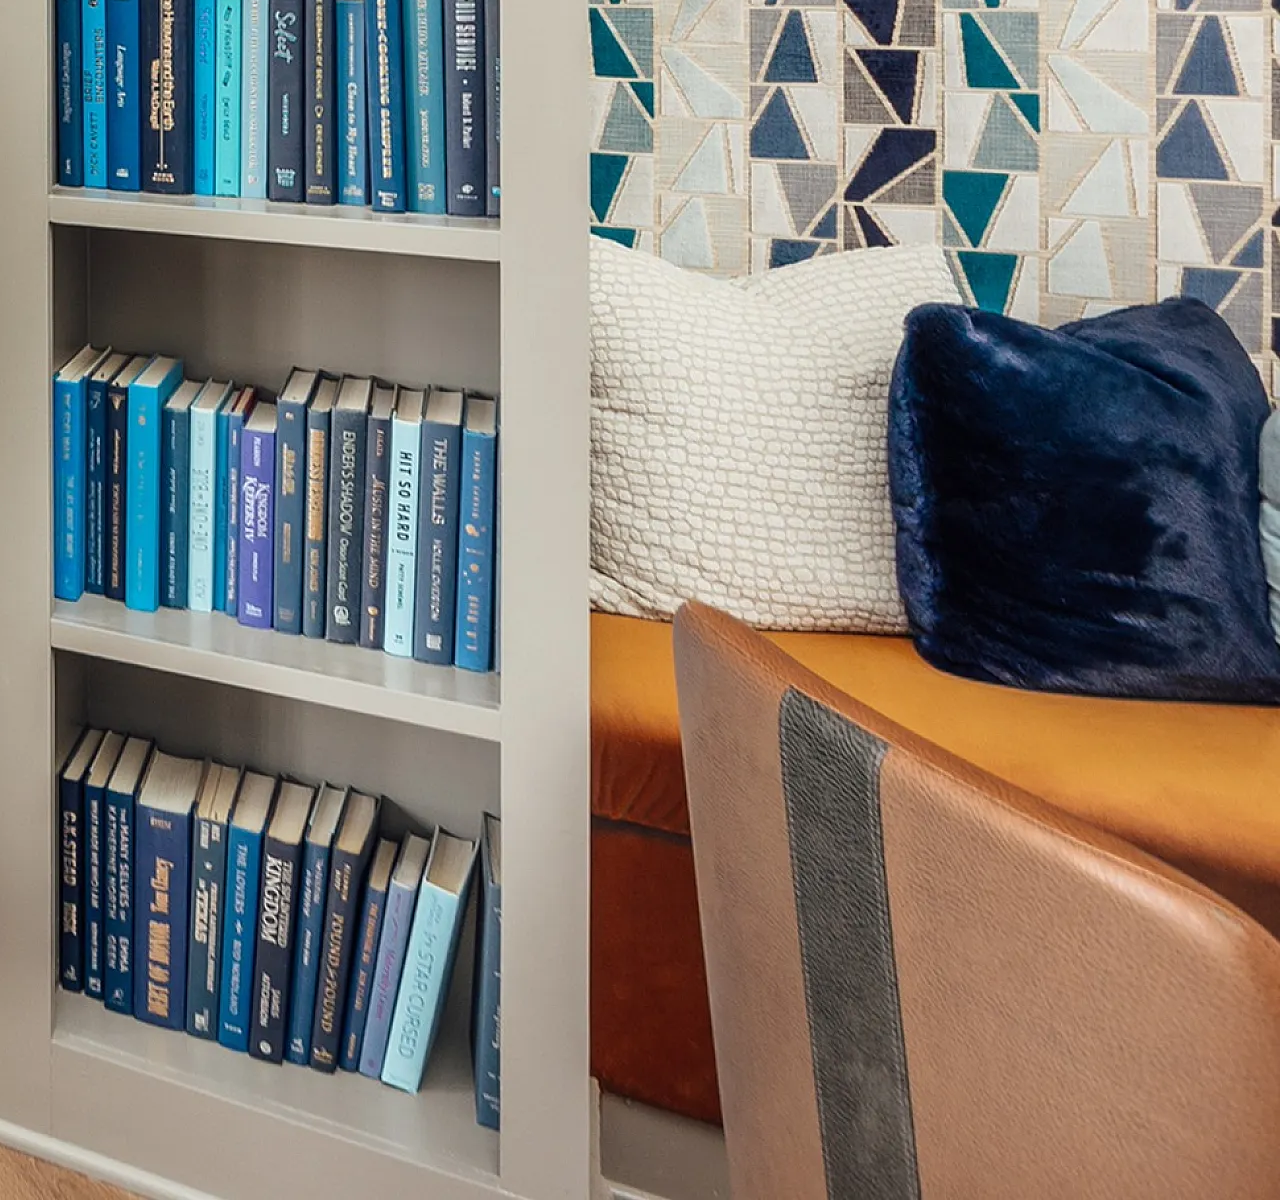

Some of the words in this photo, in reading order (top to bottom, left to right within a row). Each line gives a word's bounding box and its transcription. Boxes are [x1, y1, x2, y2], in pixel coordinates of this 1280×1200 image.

[162, 12, 174, 60] Heavens
[274, 10, 297, 65] Select
[455, 24, 476, 72] SERVICE
[94, 28, 104, 104] ENCOUNTERS
[115, 45, 127, 89] Language
[163, 61, 174, 81] and
[316, 55, 323, 67] OF
[84, 70, 93, 103] BRIEF
[116, 91, 126, 108] Arts
[163, 82, 174, 99] the
[348, 82, 358, 111] Close
[89, 112, 98, 148] CAVETT
[162, 100, 175, 131] Earth
[315, 123, 323, 142] ERIC
[347, 144, 357, 178] Heart
[380, 107, 393, 179] SAMPLER
[253, 437, 261, 467] PEARSON
[343, 431, 356, 480] ENDER'S
[400, 451, 412, 475] HIT
[434, 438, 448, 472] THE
[244, 476, 258, 527] KEEPERS
[372, 474, 385, 512] MUSIC
[398, 480, 411, 499] SO
[431, 473, 446, 526] WALLS
[256, 483, 270, 538] KINGDOM
[340, 480, 354, 537] SHADOW
[372, 516, 382, 531] IN
[396, 502, 411, 541] HARD
[168, 531, 176, 555] BONES
[244, 528, 254, 542] IV
[371, 533, 382, 555] THE
[168, 556, 176, 584] LOVELY
[369, 557, 379, 588] MIND
[107, 805, 117, 874] KATHERINE
[119, 824, 129, 860] MANY
[237, 844, 248, 868] THE
[63, 840, 77, 887] STEAD
[150, 857, 173, 890] Clancy
[107, 876, 117, 920] NORTH
[119, 862, 129, 908] SELVES
[150, 890, 168, 914] Tom
[234, 870, 247, 915] LOVERS
[261, 853, 281, 946] KINGDOM
[63, 902, 77, 936] RISK
[195, 889, 208, 945] TEXAS
[119, 937, 129, 973] EMMA
[148, 920, 170, 965] HONOR
[327, 912, 344, 968] POUND
[149, 965, 169, 982] OF
[416, 949, 436, 993] STAR
[321, 981, 337, 1032] POUND
[398, 994, 426, 1059] CURSED
